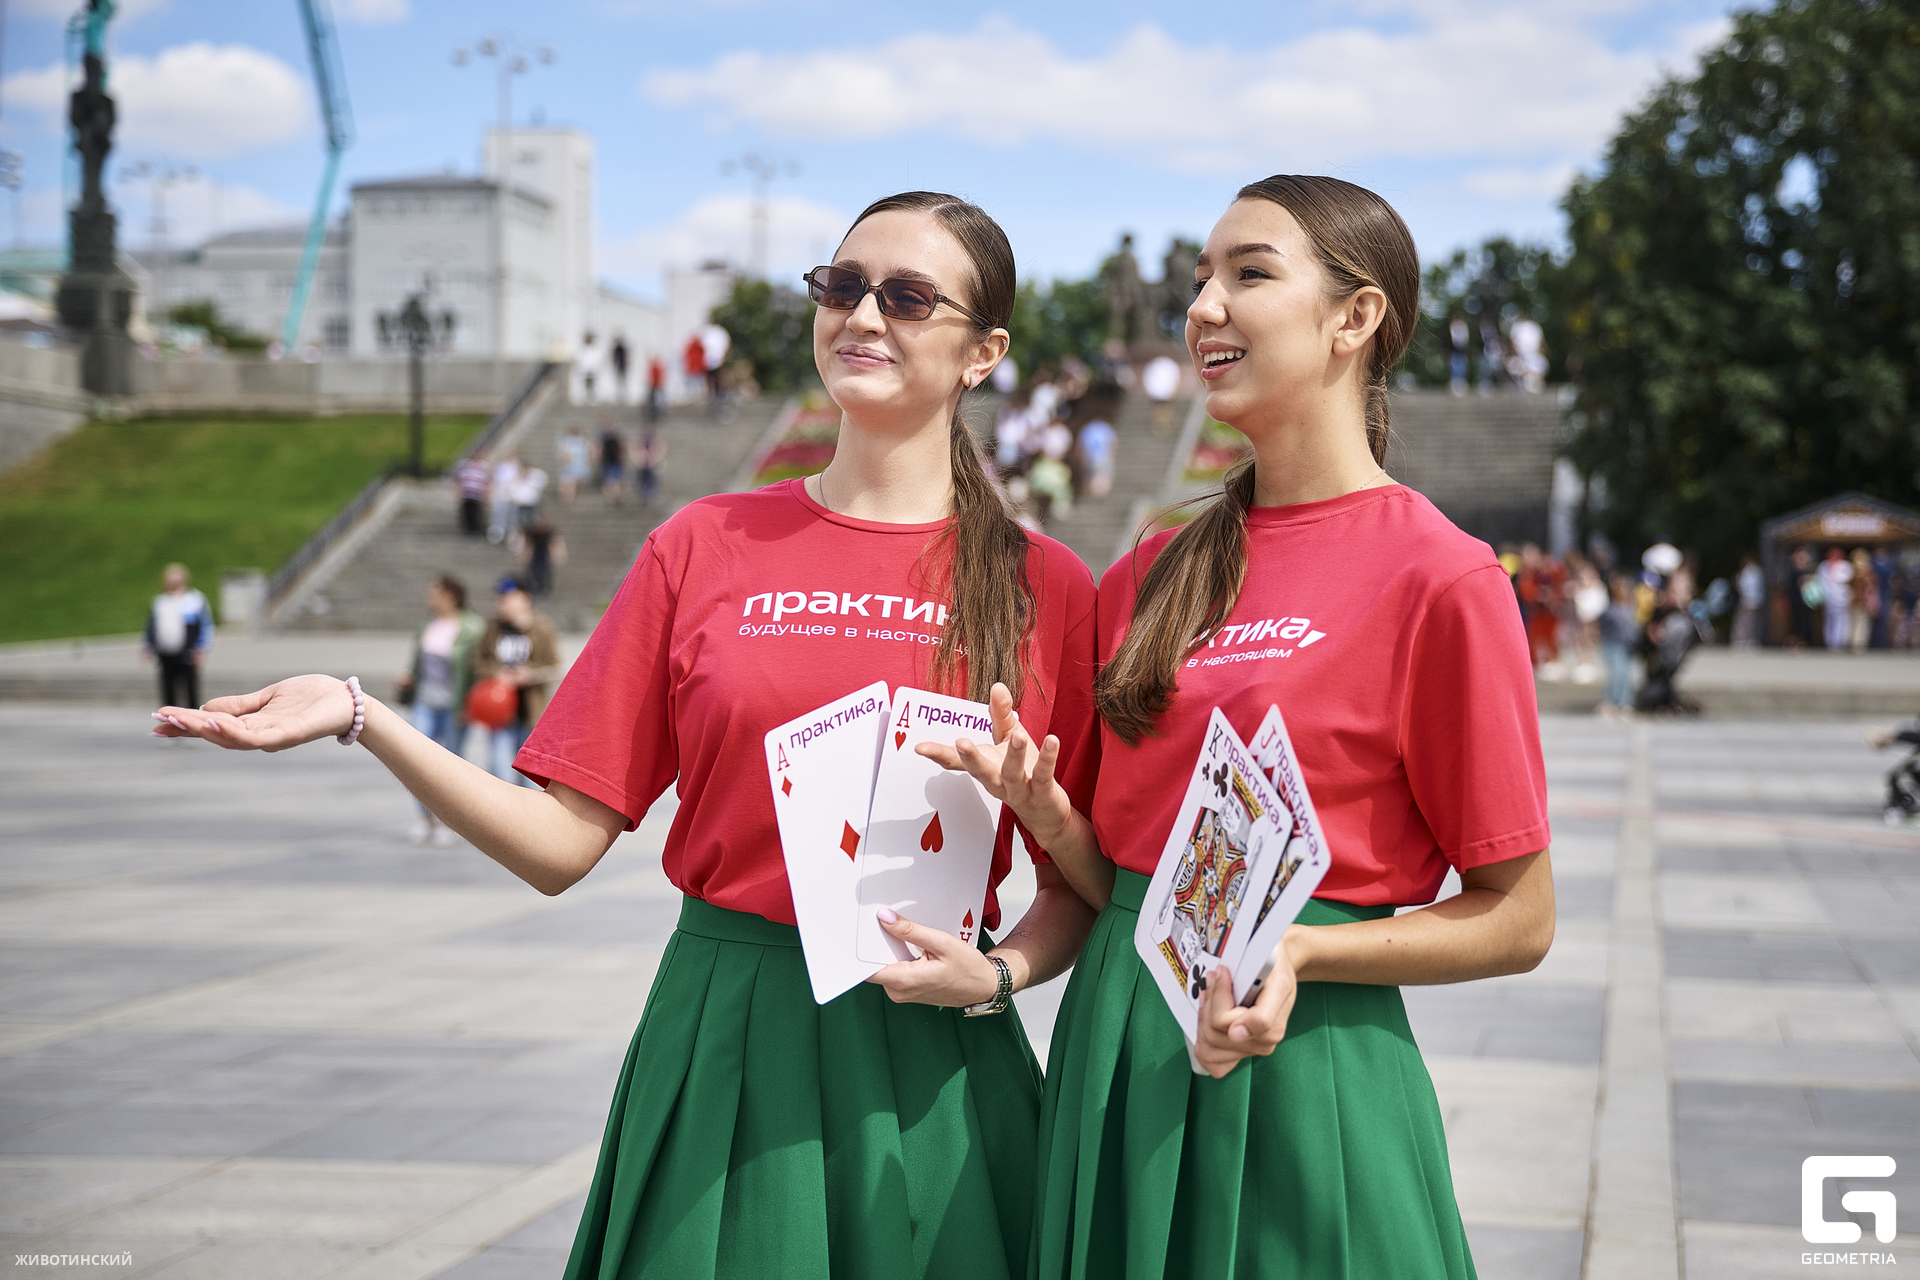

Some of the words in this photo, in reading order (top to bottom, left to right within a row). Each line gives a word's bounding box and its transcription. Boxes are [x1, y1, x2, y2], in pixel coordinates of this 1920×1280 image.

[743, 591, 959, 626] практик
[739, 623, 837, 637] будущее
[844, 627, 858, 638] в
[1186, 658, 1199, 668] в
[1201, 648, 1293, 667] настоящем
[897, 701, 910, 728] A
[917, 704, 993, 733] практик
[1208, 723, 1223, 759] K
[1260, 725, 1277, 750] J
[777, 742, 790, 771] A
